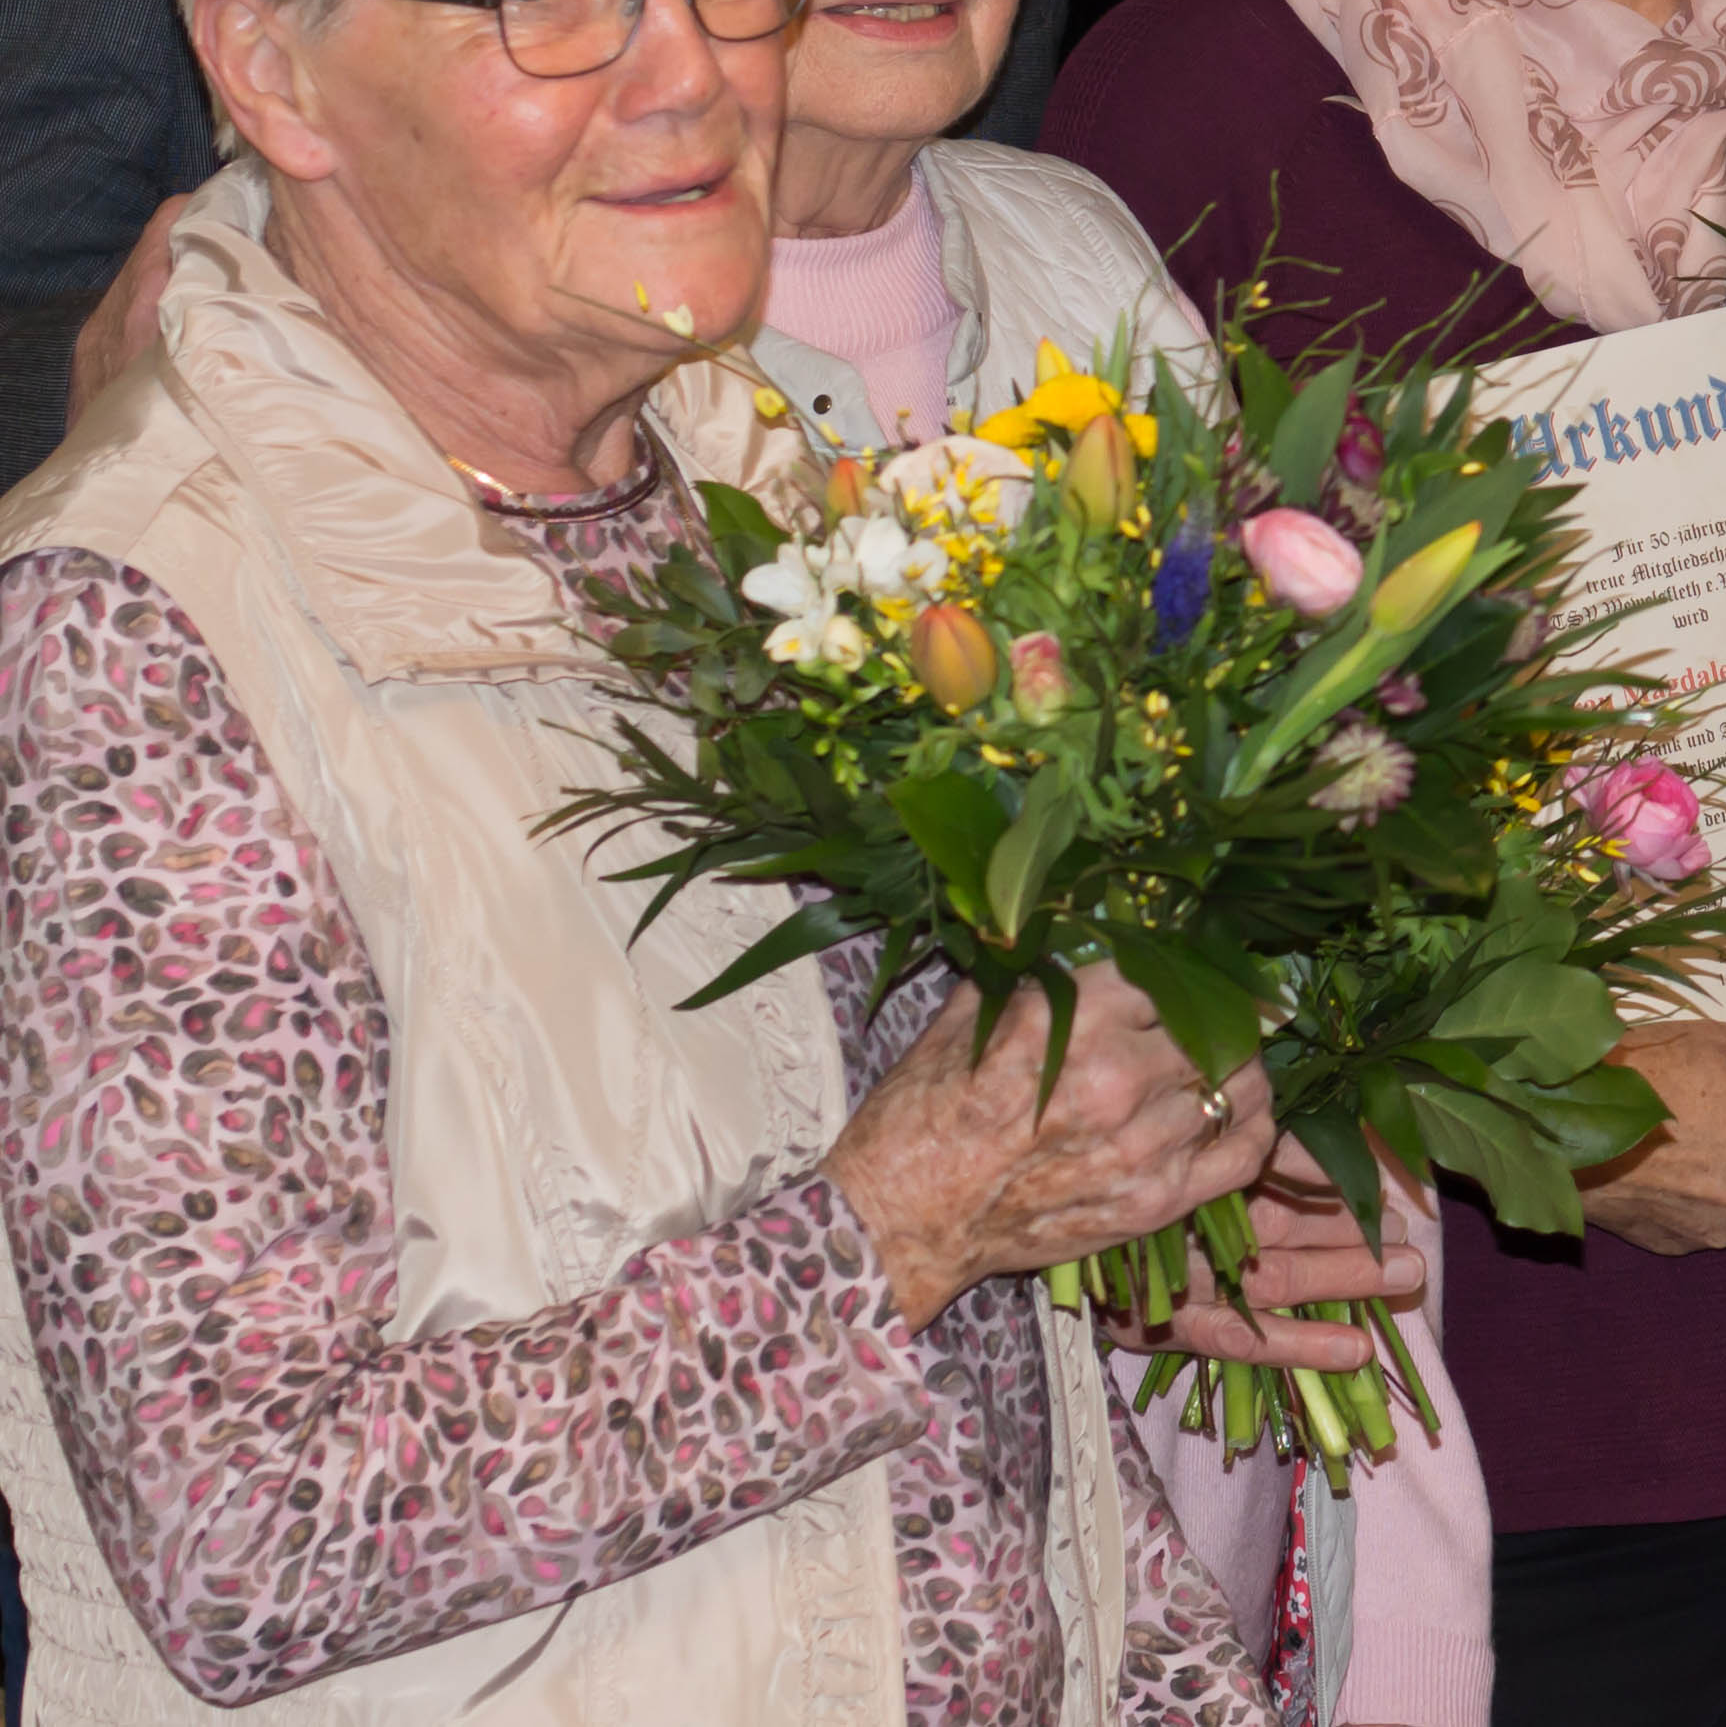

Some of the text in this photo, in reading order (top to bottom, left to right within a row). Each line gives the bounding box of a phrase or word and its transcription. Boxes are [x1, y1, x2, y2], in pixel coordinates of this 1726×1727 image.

[1612, 538, 1644, 563] Für
[1585, 574, 1625, 594] treue
[1672, 608, 1709, 630] wird
[1686, 729, 1716, 748] und
